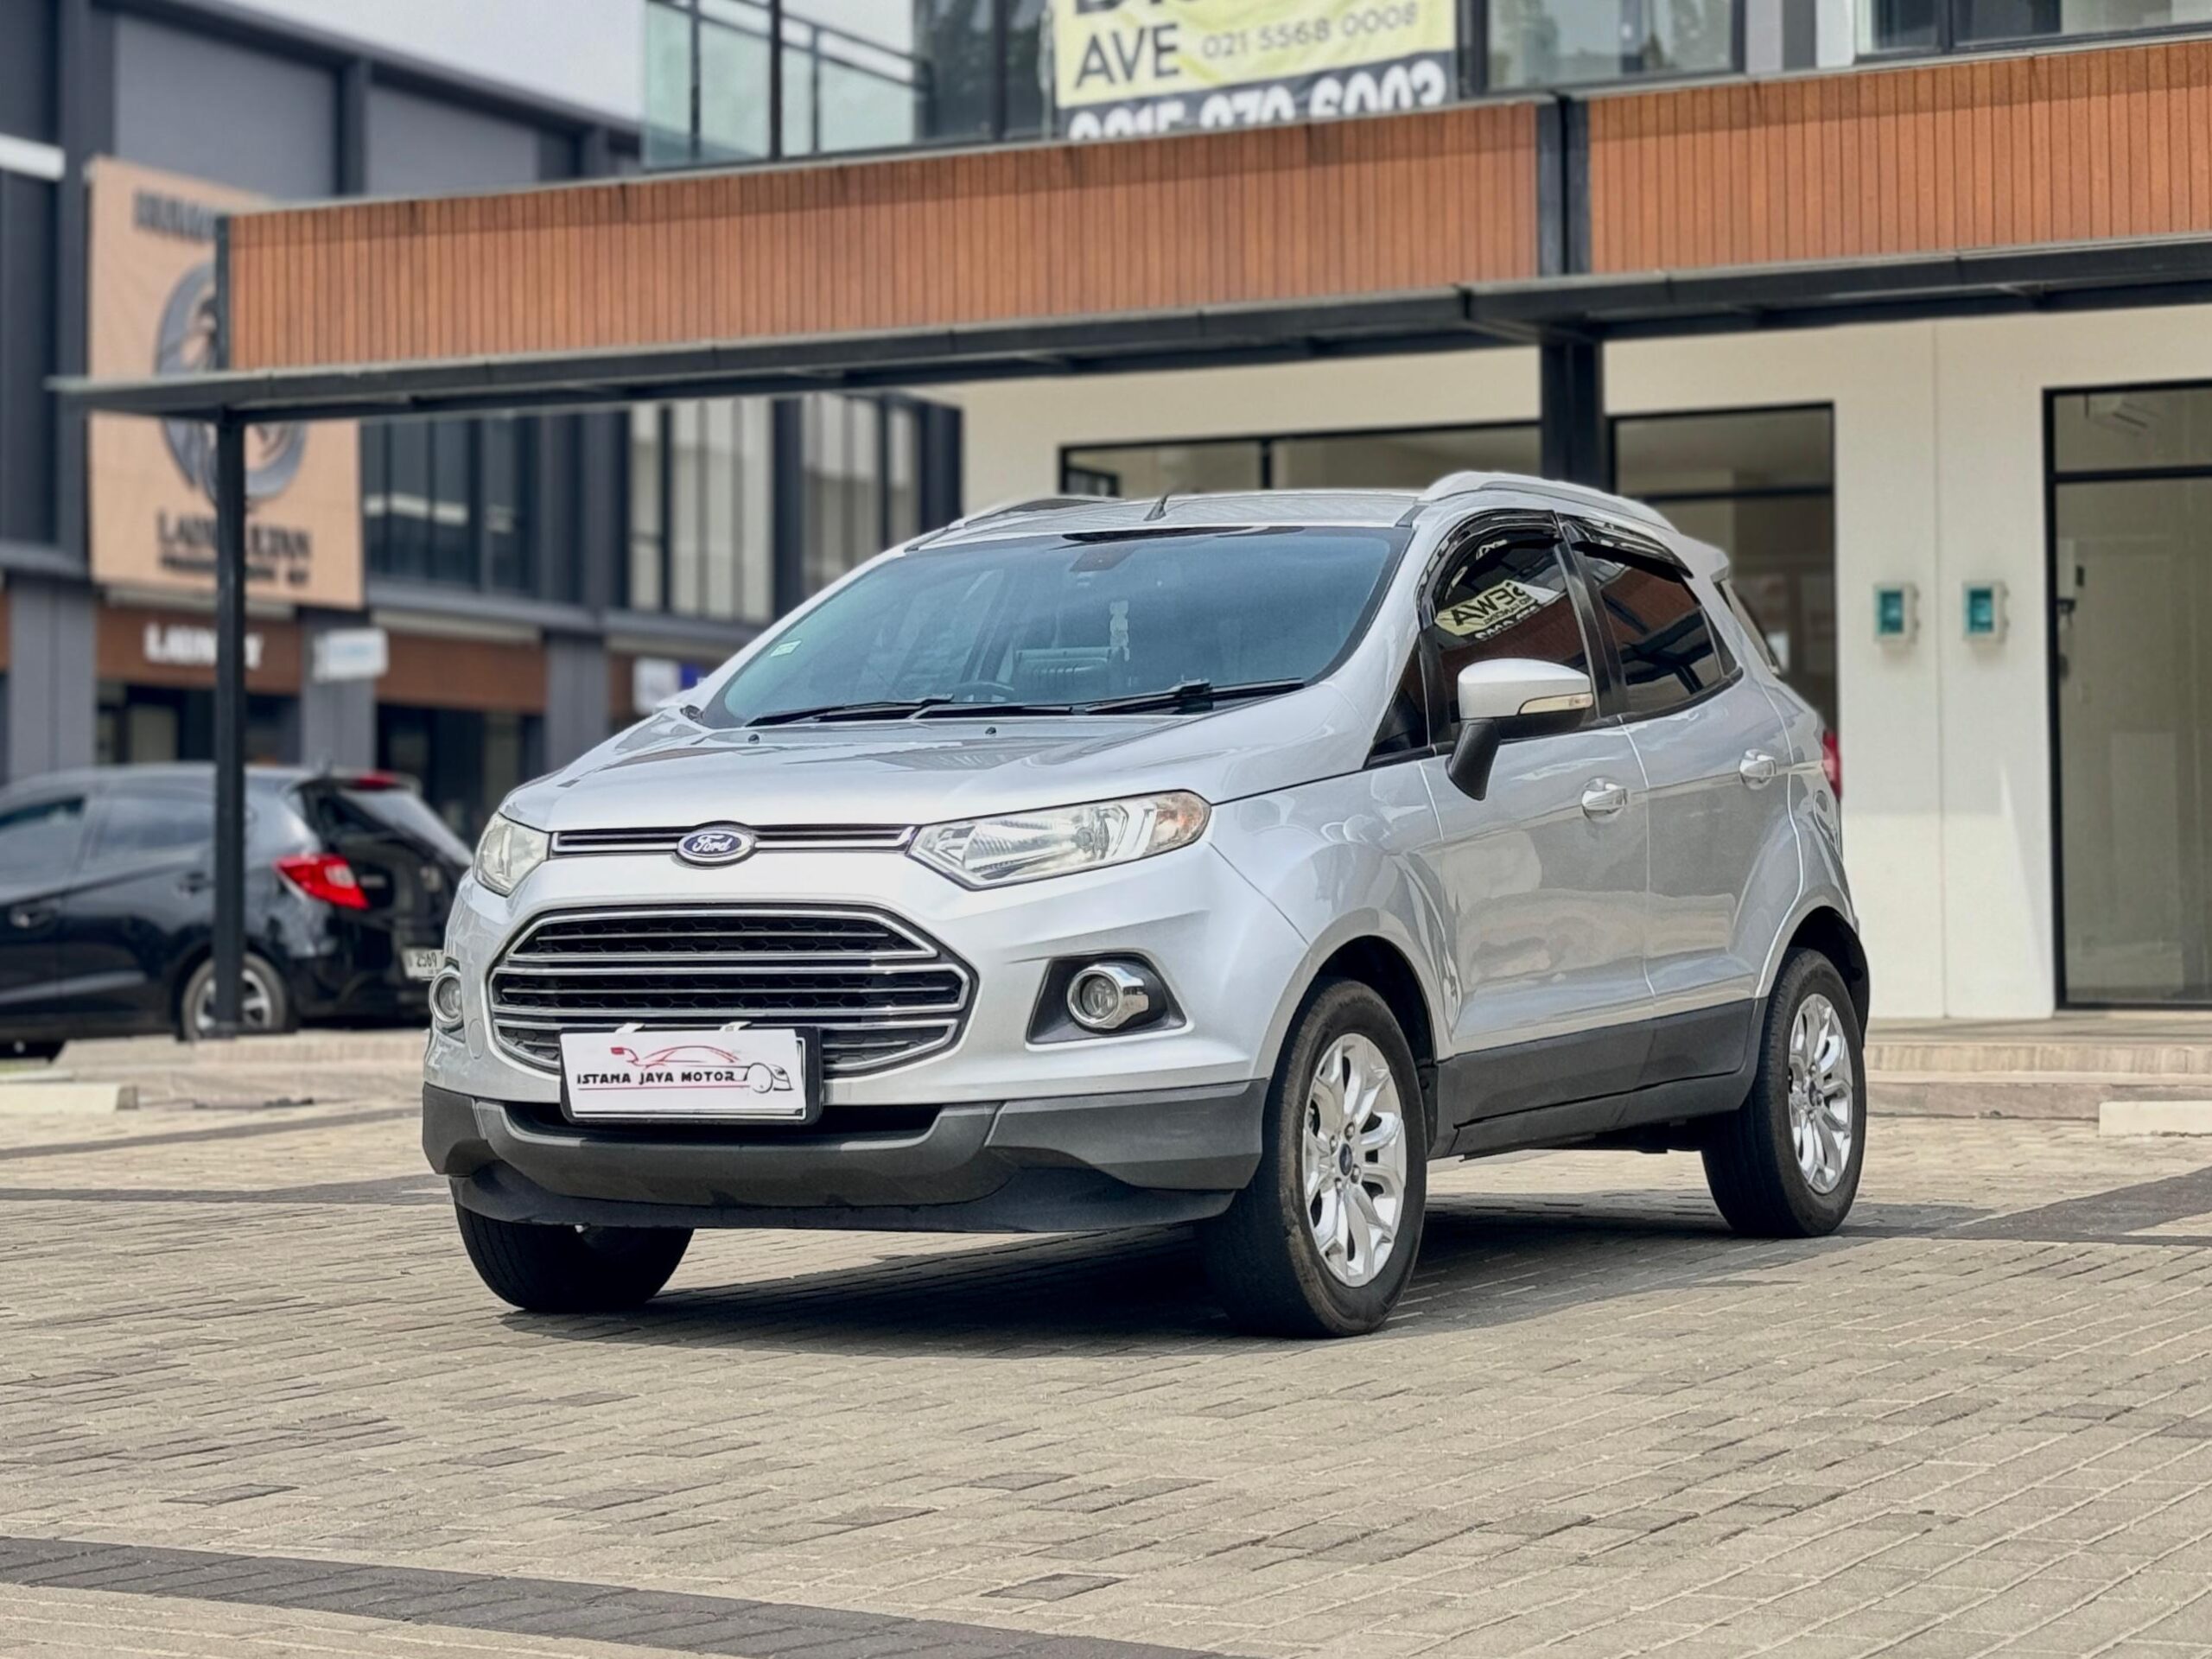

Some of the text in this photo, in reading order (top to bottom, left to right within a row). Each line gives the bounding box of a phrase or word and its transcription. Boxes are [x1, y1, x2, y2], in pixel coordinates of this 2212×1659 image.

[1074, 22, 1180, 89] AVE
[1202, 30, 1248, 59] 021
[692, 835, 734, 852] Ford
[577, 1071, 735, 1085] ISTANA JAYA MOTOR
